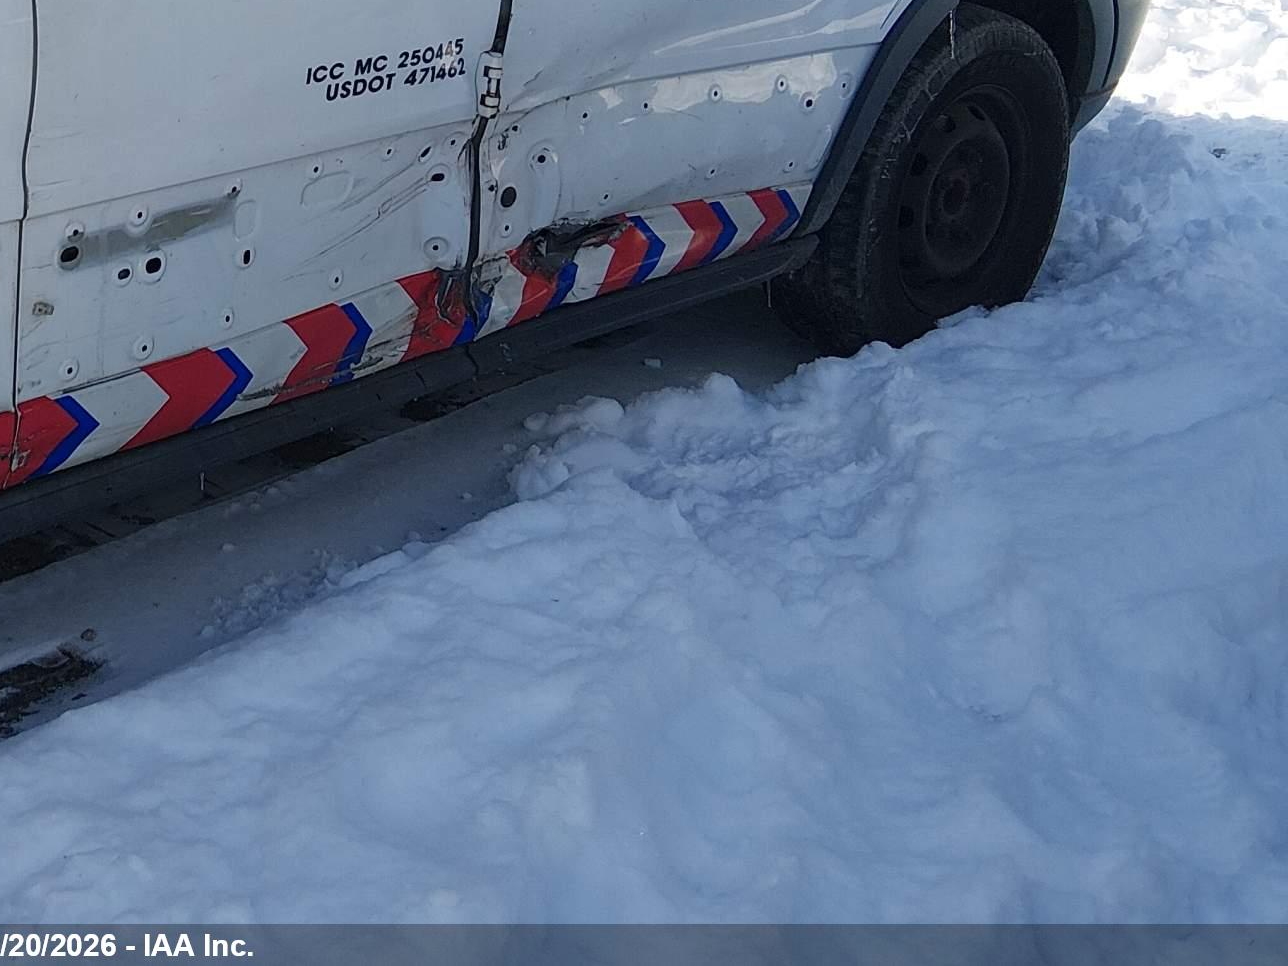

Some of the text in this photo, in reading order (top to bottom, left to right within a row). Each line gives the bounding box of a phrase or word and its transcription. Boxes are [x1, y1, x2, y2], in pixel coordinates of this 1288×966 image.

[305, 38, 465, 85] ICC MC 250445
[326, 58, 466, 101] USDOT 471462
